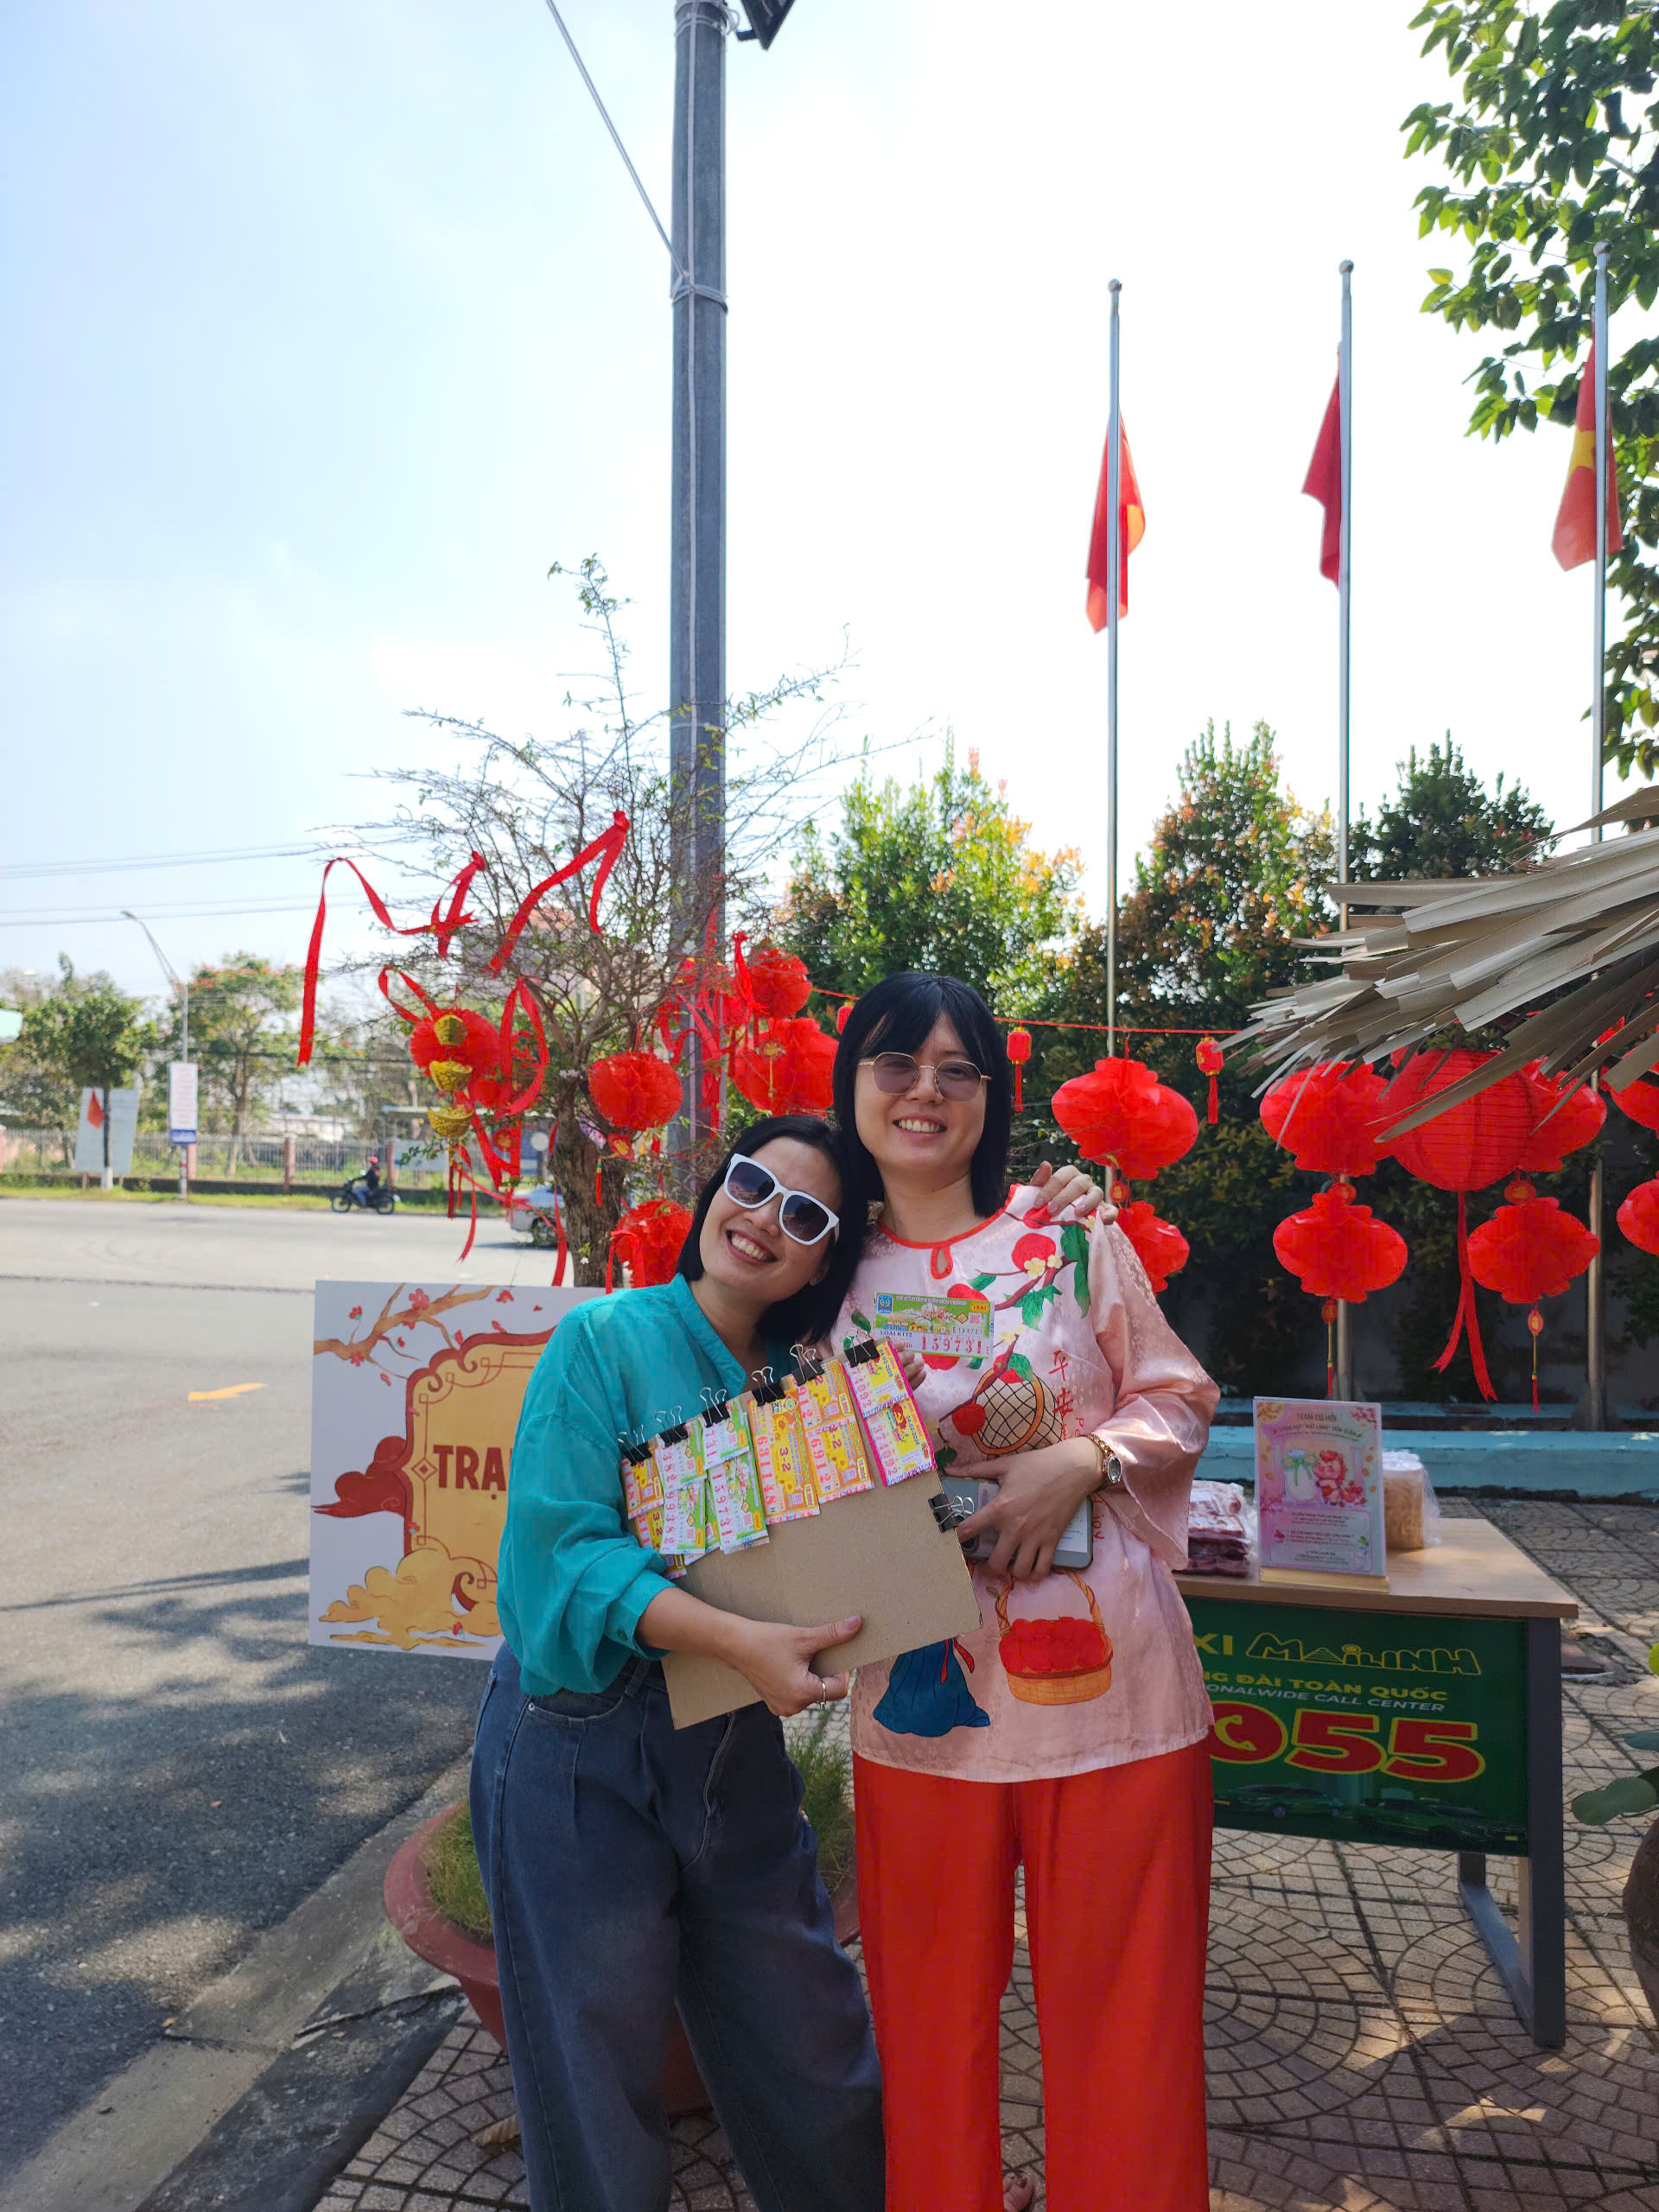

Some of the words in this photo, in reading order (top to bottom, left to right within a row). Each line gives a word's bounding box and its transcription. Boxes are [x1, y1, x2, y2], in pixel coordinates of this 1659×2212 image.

[921, 1335, 982, 1355] 159731
[798, 1385, 813, 1419] 912
[1075, 1417, 1084, 1437] Pe
[433, 1444, 512, 1501] TRẠ
[756, 1435, 777, 1505] 631148
[779, 1447, 792, 1472] 3-2
[1193, 1633, 1233, 1656] XI
[1206, 1683, 1308, 1700] ONALWIDE
[1314, 1693, 1363, 1706] CALL
[1368, 1698, 1446, 1712] CENTER
[1236, 1671, 1281, 1688] ĐÀI
[1292, 1676, 1362, 1694] TOÀN
[1369, 1686, 1449, 1701] QUỐC
[1209, 1700, 1486, 1783] 055
